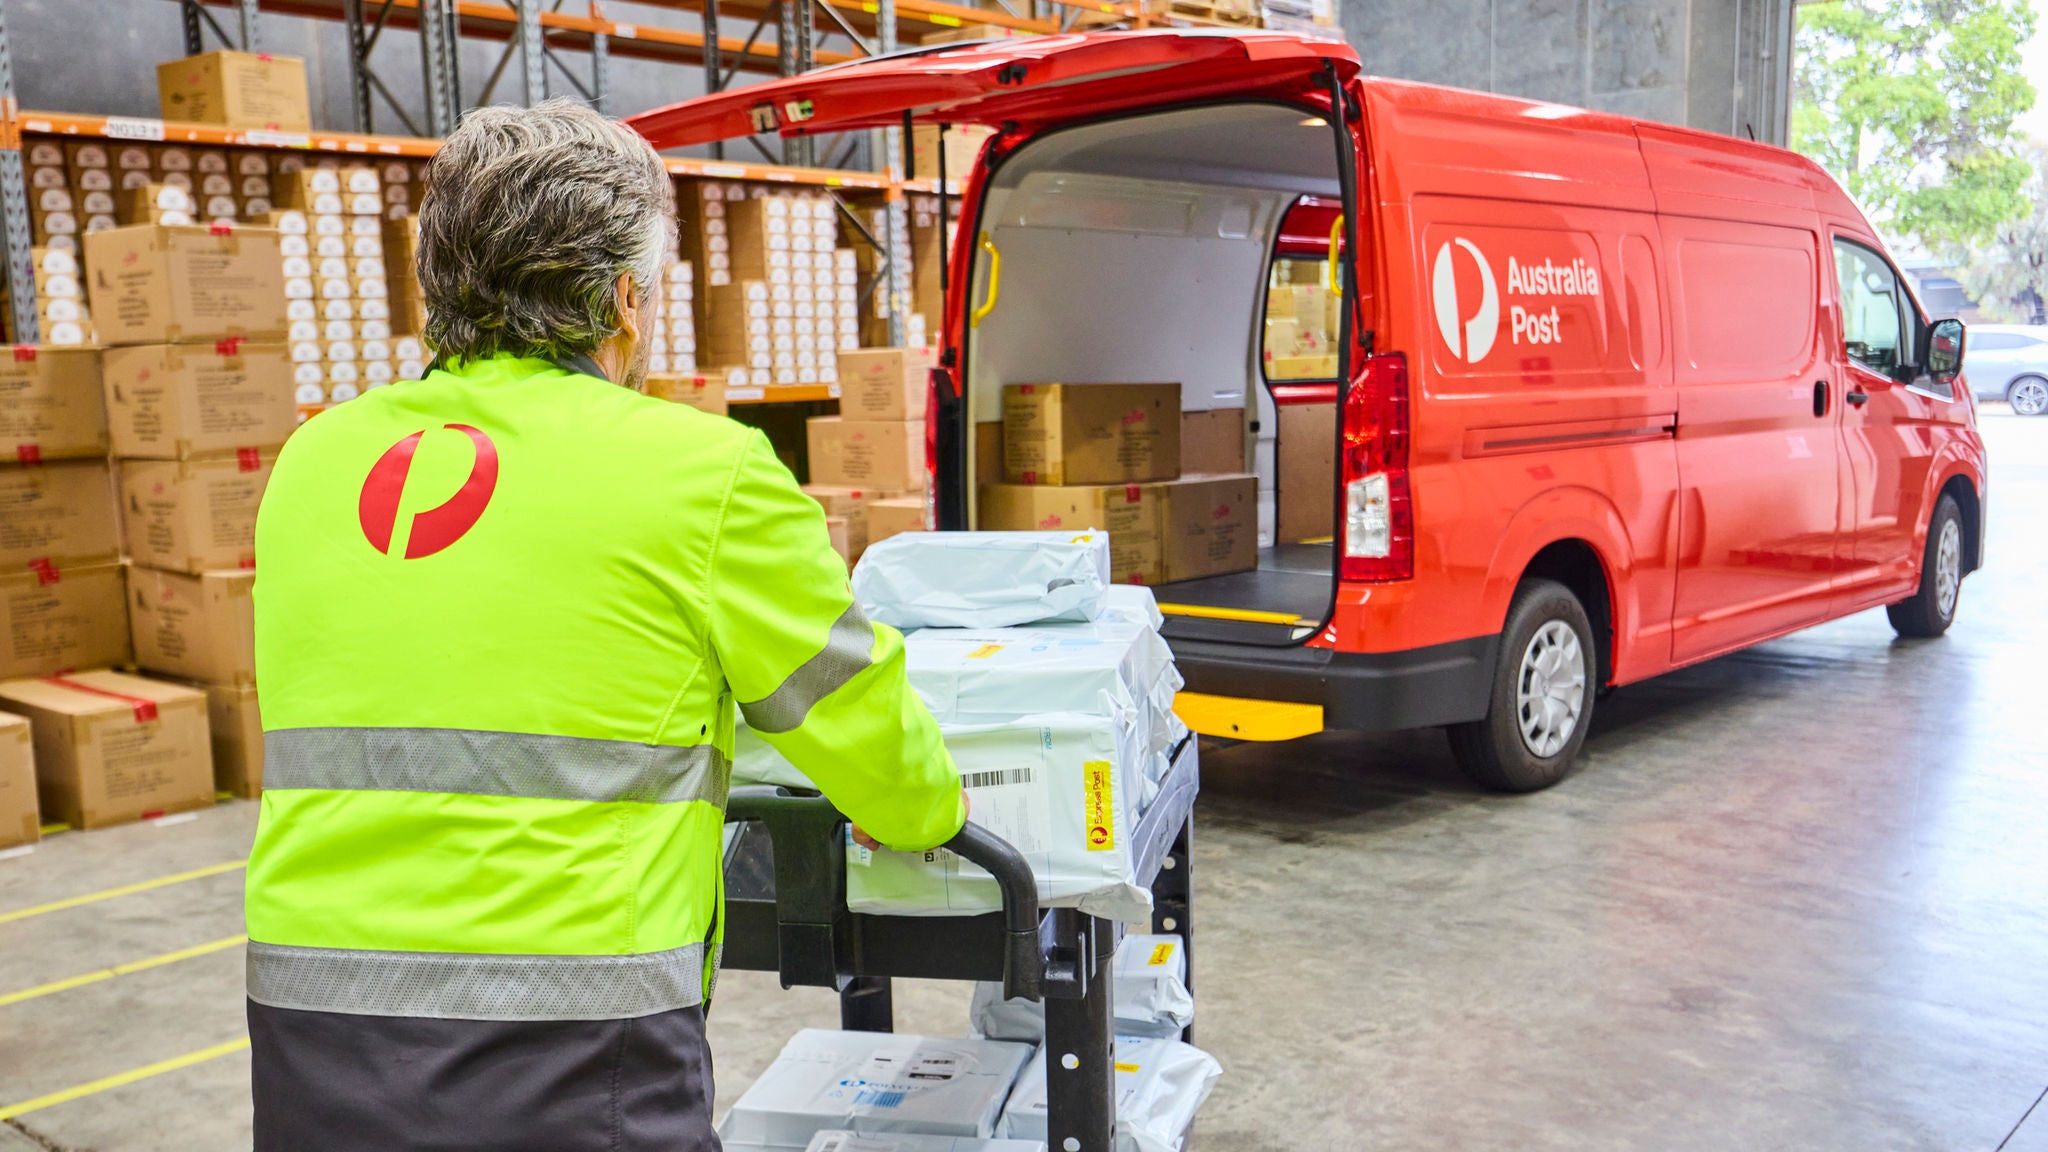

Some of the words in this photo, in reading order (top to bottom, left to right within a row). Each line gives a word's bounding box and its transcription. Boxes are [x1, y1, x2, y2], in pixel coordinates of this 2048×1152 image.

[1508, 256, 1599, 295] Australia
[1511, 305, 1562, 344] Post
[1093, 771, 1101, 790] Post
[1094, 791, 1103, 824] Express
